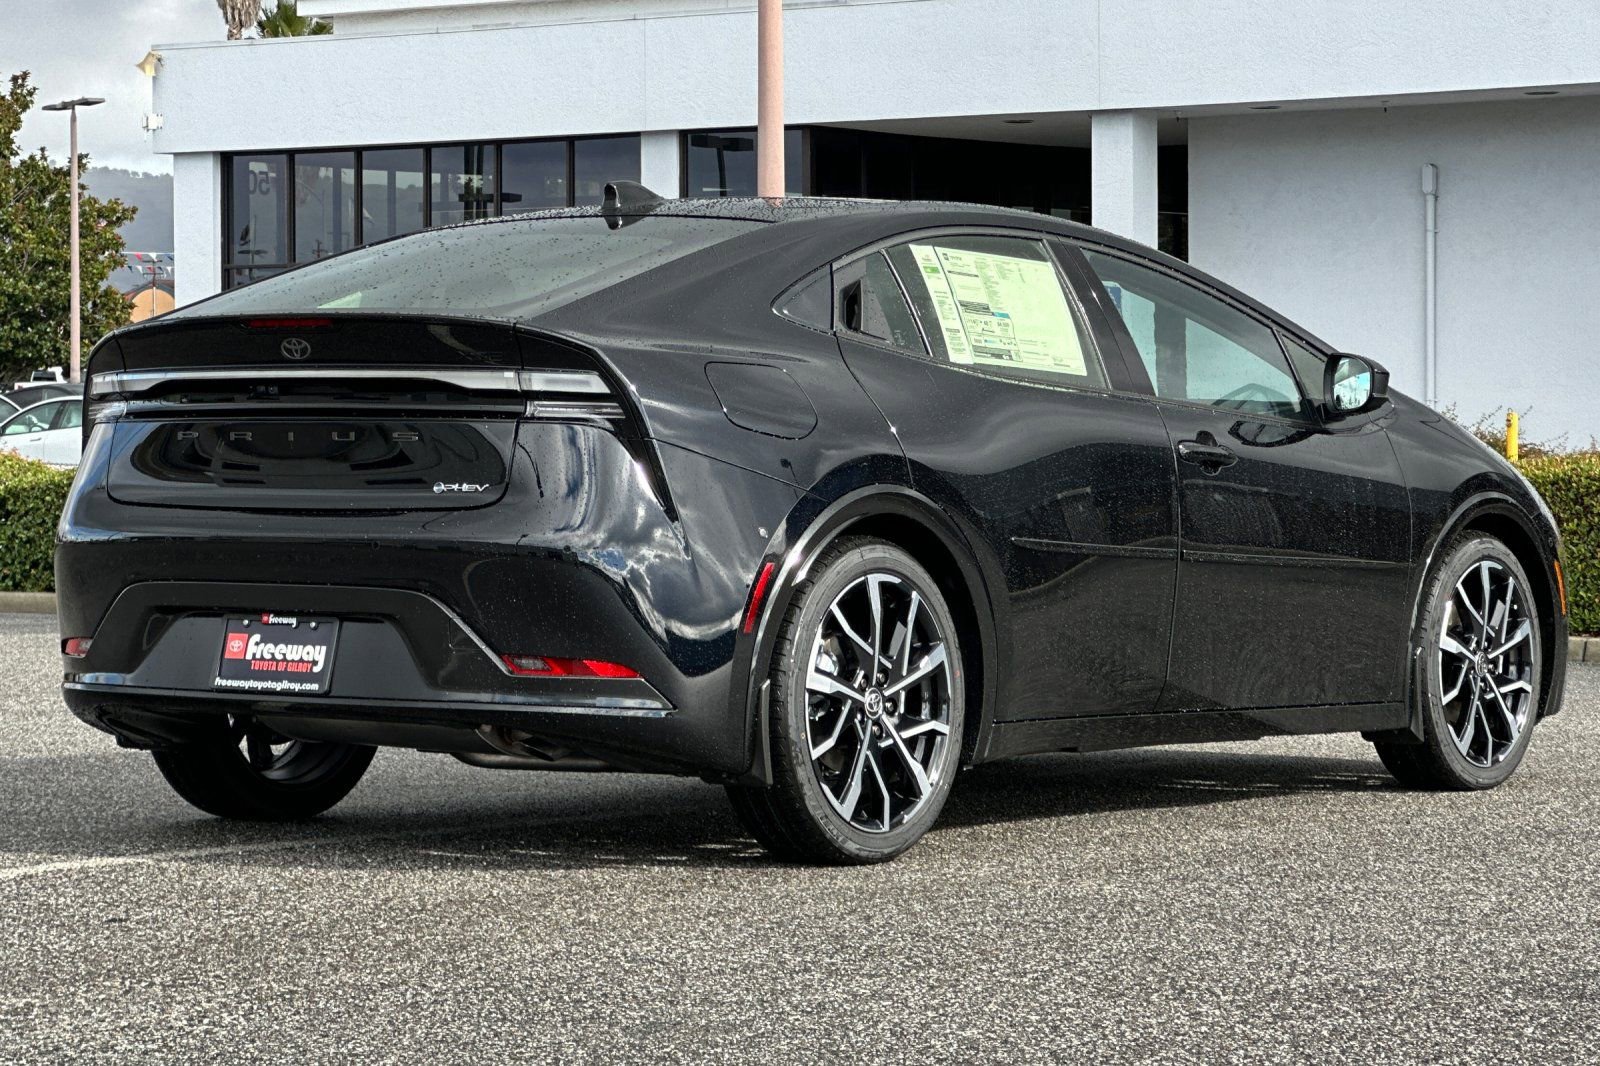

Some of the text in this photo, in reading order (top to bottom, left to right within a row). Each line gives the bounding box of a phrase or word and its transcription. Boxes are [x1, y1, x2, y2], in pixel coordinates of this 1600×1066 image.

[177, 431, 418, 441] PRIUS
[268, 614, 297, 628] freeway
[245, 634, 327, 673] freeway
[250, 660, 312, 673] TOYOTA OF GILROY
[214, 677, 319, 692] freewaytoyotagilroy.com
